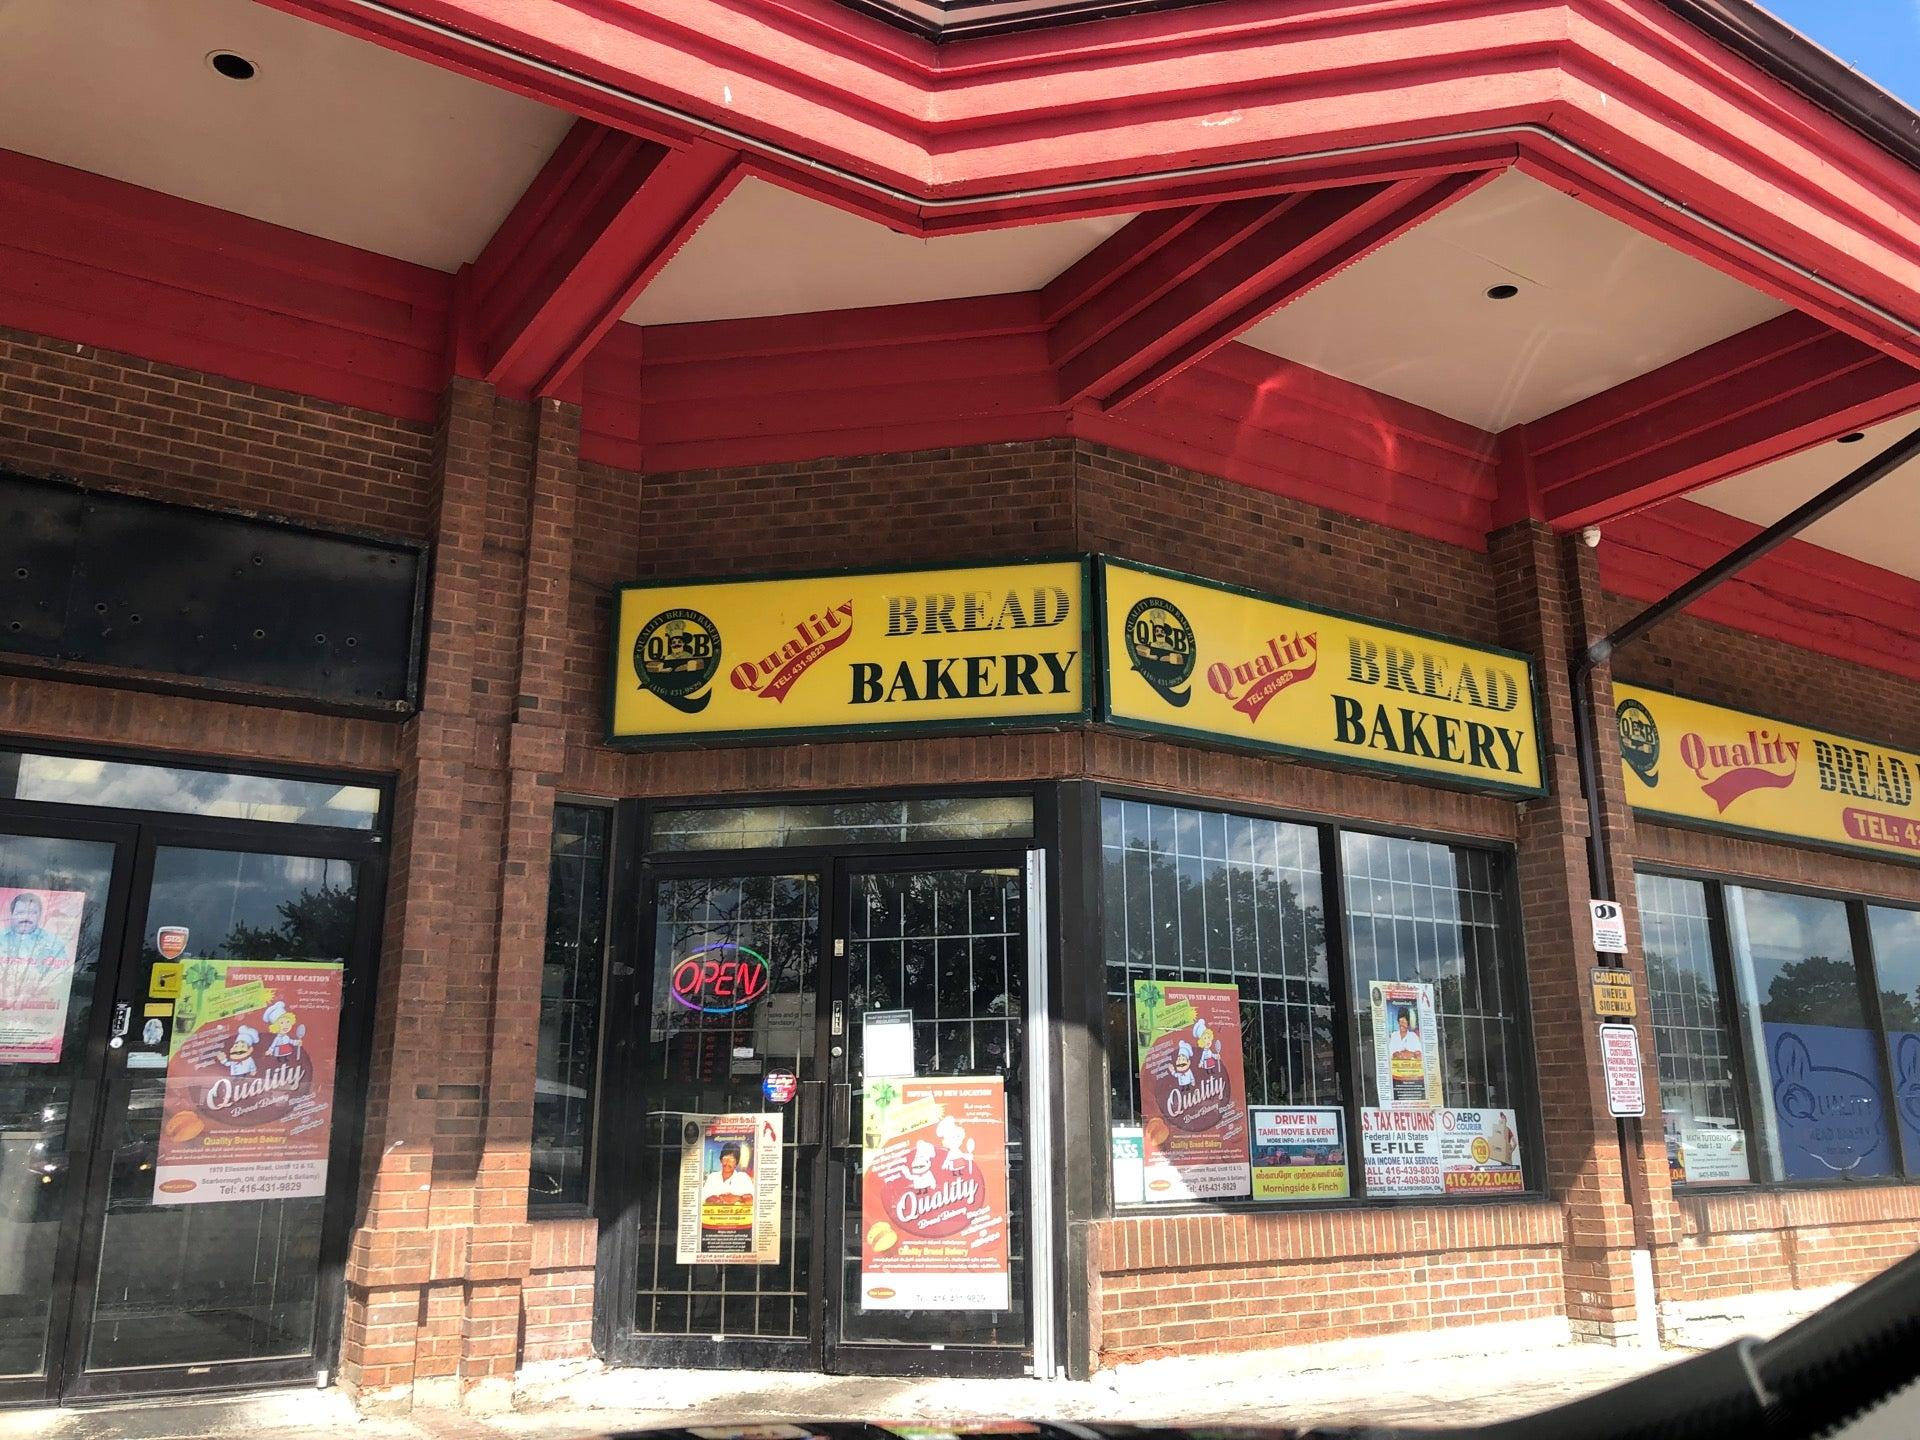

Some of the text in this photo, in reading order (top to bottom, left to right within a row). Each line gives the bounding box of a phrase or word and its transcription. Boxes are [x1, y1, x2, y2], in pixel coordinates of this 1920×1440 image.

[884, 585, 1071, 637] BREAD
[1149, 599, 1175, 613] BREAD
[666, 610, 697, 620] BREAD
[697, 615, 720, 646] BAKERY
[730, 598, 853, 692] Quality
[773, 643, 827, 690] TEL: 431-9829
[1207, 629, 1318, 701] Quality
[847, 651, 1079, 705] BAKERY
[1347, 635, 1518, 712] BREAD
[1246, 691, 1265, 706] TEL:
[1330, 693, 1525, 775] BAKERY
[1680, 729, 1800, 781] Quality
[1812, 739, 1913, 807] BREAD
[1853, 812, 1900, 843] TEL:
[263, 974, 274, 982] TO
[275, 974, 292, 982] NEW
[293, 974, 330, 983] LOCATION
[674, 961, 762, 996] OPEN
[1594, 971, 1632, 985] CAUTION
[1207, 994, 1231, 1002] LOCATION
[1601, 987, 1627, 999] UNEVEN
[1599, 1000, 1632, 1012] SIDEWALK
[206, 1062, 306, 1111] Quality
[959, 1089, 992, 1097] LOCATION
[1167, 1075, 1226, 1118] Quality
[231, 1094, 290, 1118] Bread Bakery
[1275, 1115, 1317, 1124] DRIVE IN
[1373, 1111, 1392, 1131] TAX
[1393, 1111, 1435, 1131] RETURNS
[1456, 1112, 1481, 1122] AERO
[1258, 1128, 1280, 1136] TAMIL
[1281, 1128, 1304, 1136] MOVIE
[1312, 1128, 1335, 1136] EVENT
[1456, 1123, 1482, 1131] COURIER
[204, 1135, 288, 1147] Quality Bread Bakery
[1364, 1132, 1391, 1141] Federal
[1397, 1132, 1406, 1140] All
[1408, 1132, 1429, 1140] States
[1702, 1134, 1732, 1142] TUTORING
[1170, 1139, 1222, 1149] Quality Bread Bakery
[1371, 1142, 1425, 1154] E-FILE
[1377, 1157, 1401, 1165] INCOME
[1402, 1157, 1413, 1165] TAX
[1414, 1156, 1439, 1165] SERVICE
[1365, 1166, 1440, 1175] ALL 416-439-8030
[202, 1176, 242, 1185] Scarborough,
[1366, 1175, 1440, 1185] ELL 647-409-8030
[1446, 1172, 1521, 1187] 416.292.0444
[220, 1182, 302, 1195] Tel: 416-431-9829
[1198, 1182, 1237, 1192] 416-431-9829
[1263, 1184, 1310, 1194] Morningside
[1318, 1183, 1338, 1191] Finch
[896, 1176, 979, 1223] Quality
[918, 1217, 941, 1230] Bread
[923, 1247, 944, 1255] Bread
